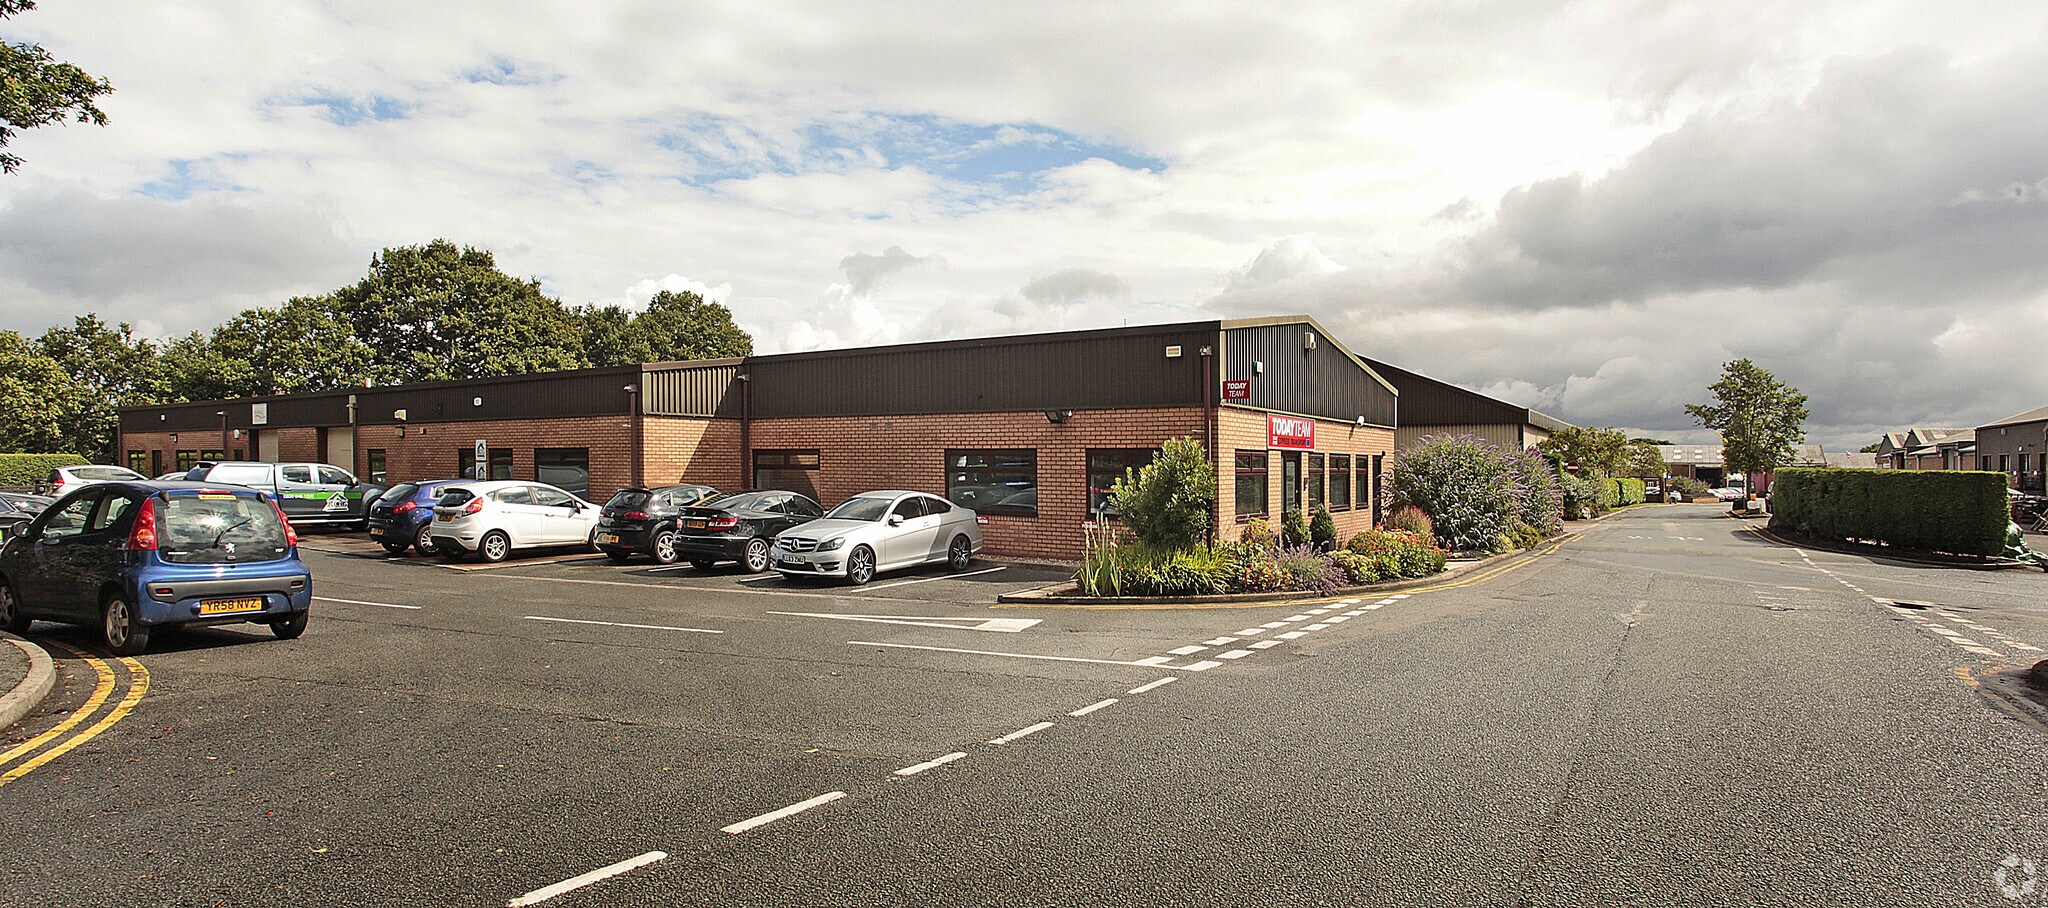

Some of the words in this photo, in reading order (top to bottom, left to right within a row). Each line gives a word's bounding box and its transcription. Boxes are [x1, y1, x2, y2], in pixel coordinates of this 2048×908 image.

[1229, 390, 1245, 398] TEAM
[207, 600, 235, 611] YR58
[237, 599, 257, 609] NVZ
